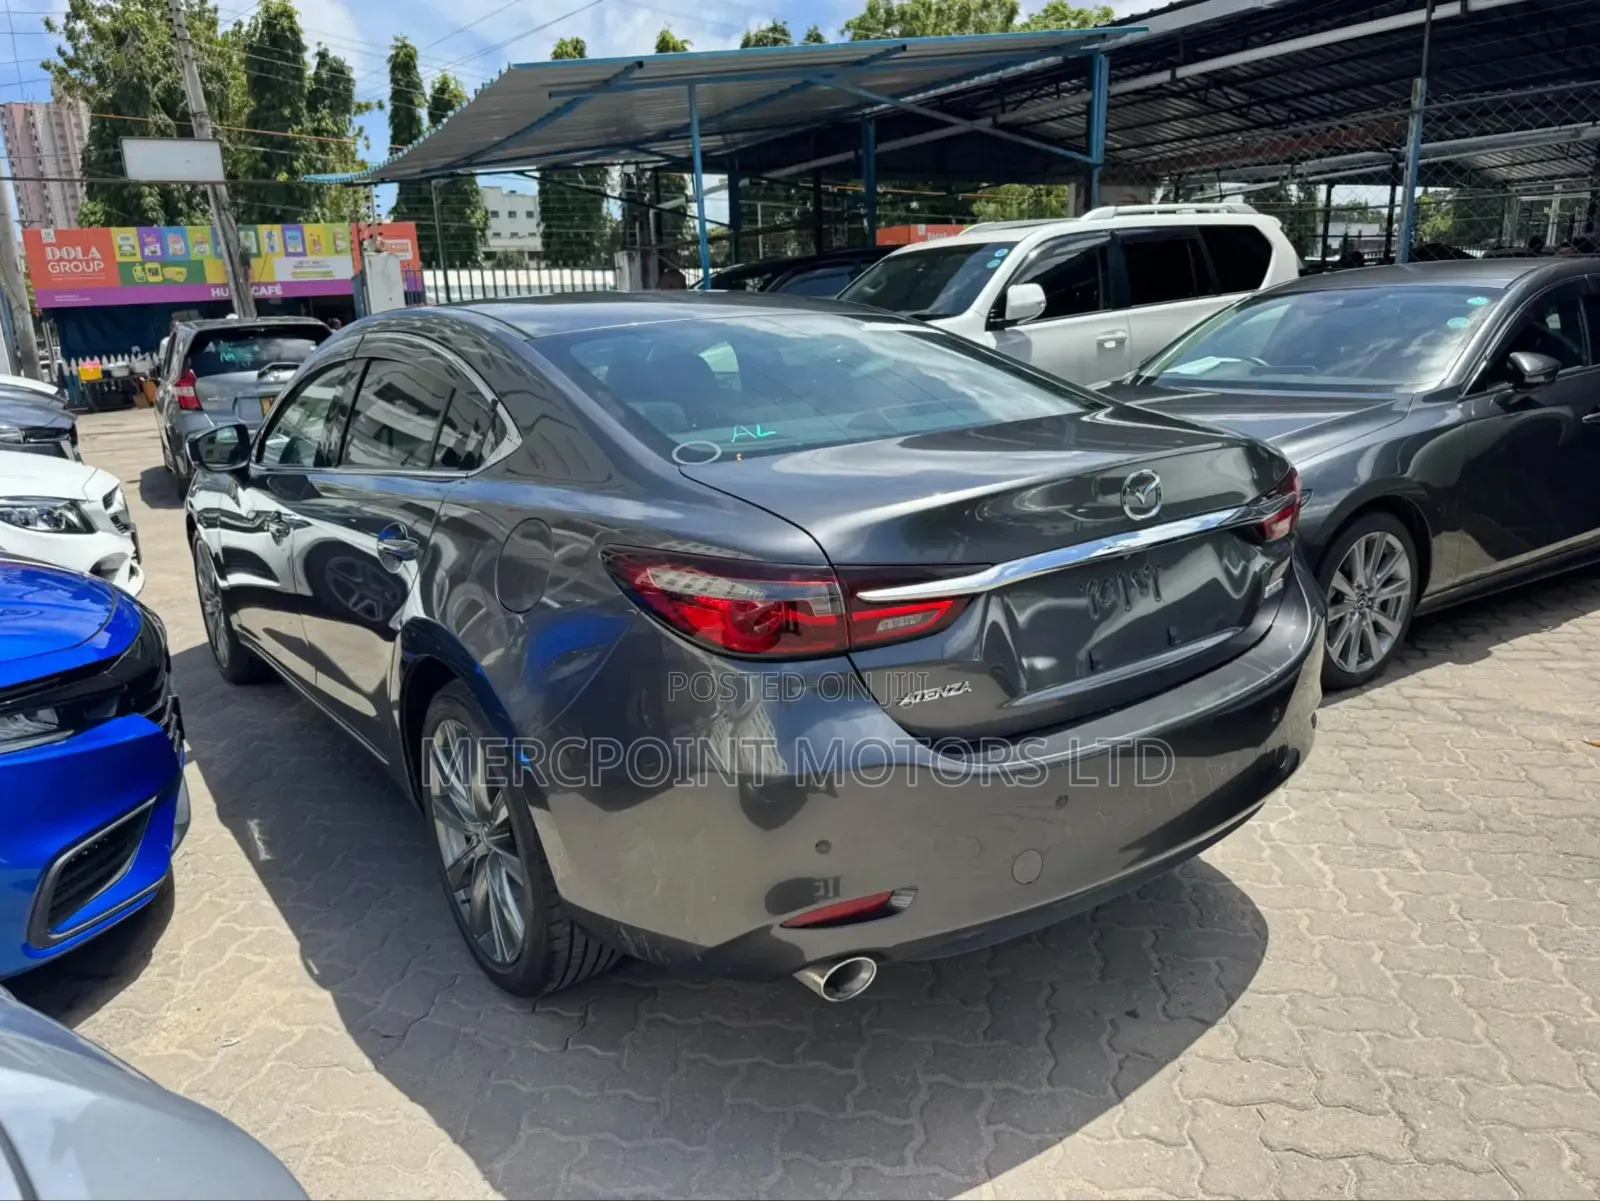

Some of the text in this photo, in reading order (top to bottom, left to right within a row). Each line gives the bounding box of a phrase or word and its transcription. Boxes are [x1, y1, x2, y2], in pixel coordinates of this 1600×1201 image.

[45, 246, 102, 260] DOLA
[48, 261, 104, 273] GROUP
[251, 283, 284, 297] CAFÉ
[897, 680, 972, 706] ATENZA
